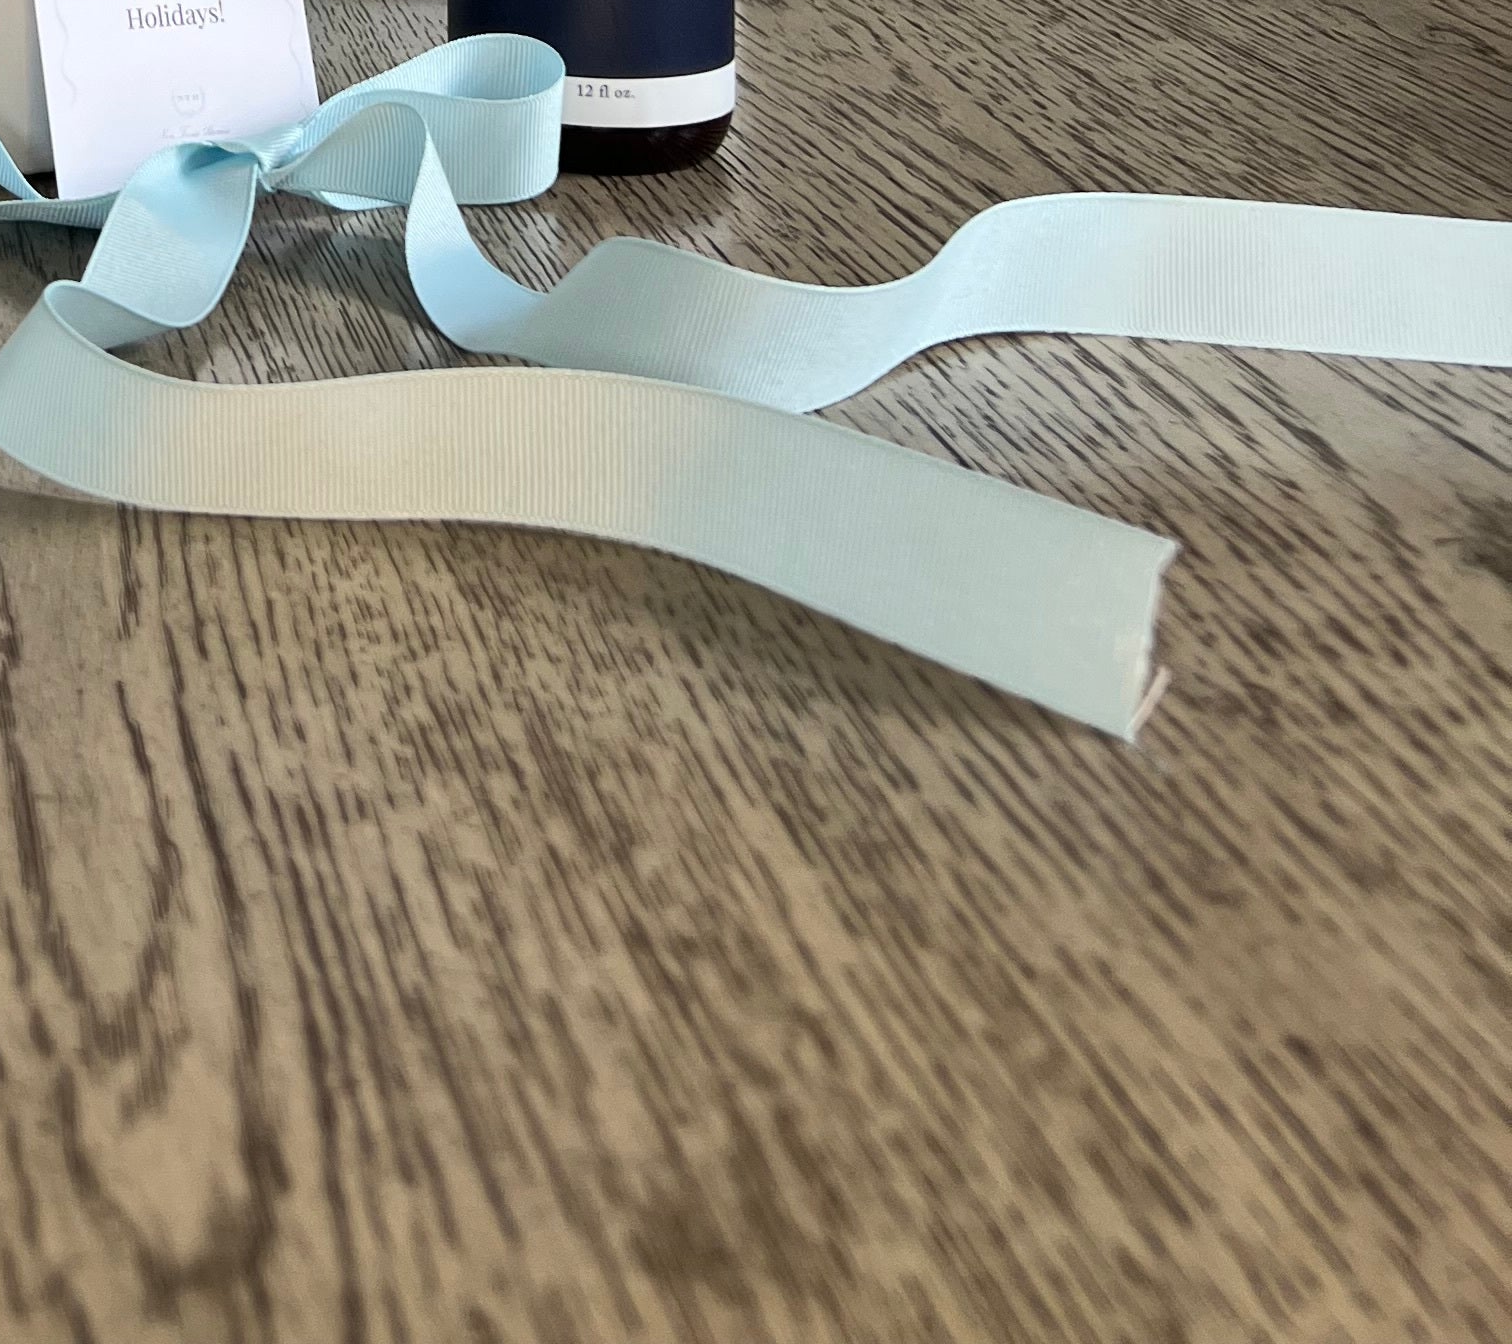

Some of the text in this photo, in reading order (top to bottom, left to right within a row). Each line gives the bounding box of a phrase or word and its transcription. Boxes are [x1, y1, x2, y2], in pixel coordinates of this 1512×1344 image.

[126, 0, 225, 30] Holidays!
[578, 84, 636, 99] 12 fl oz.
